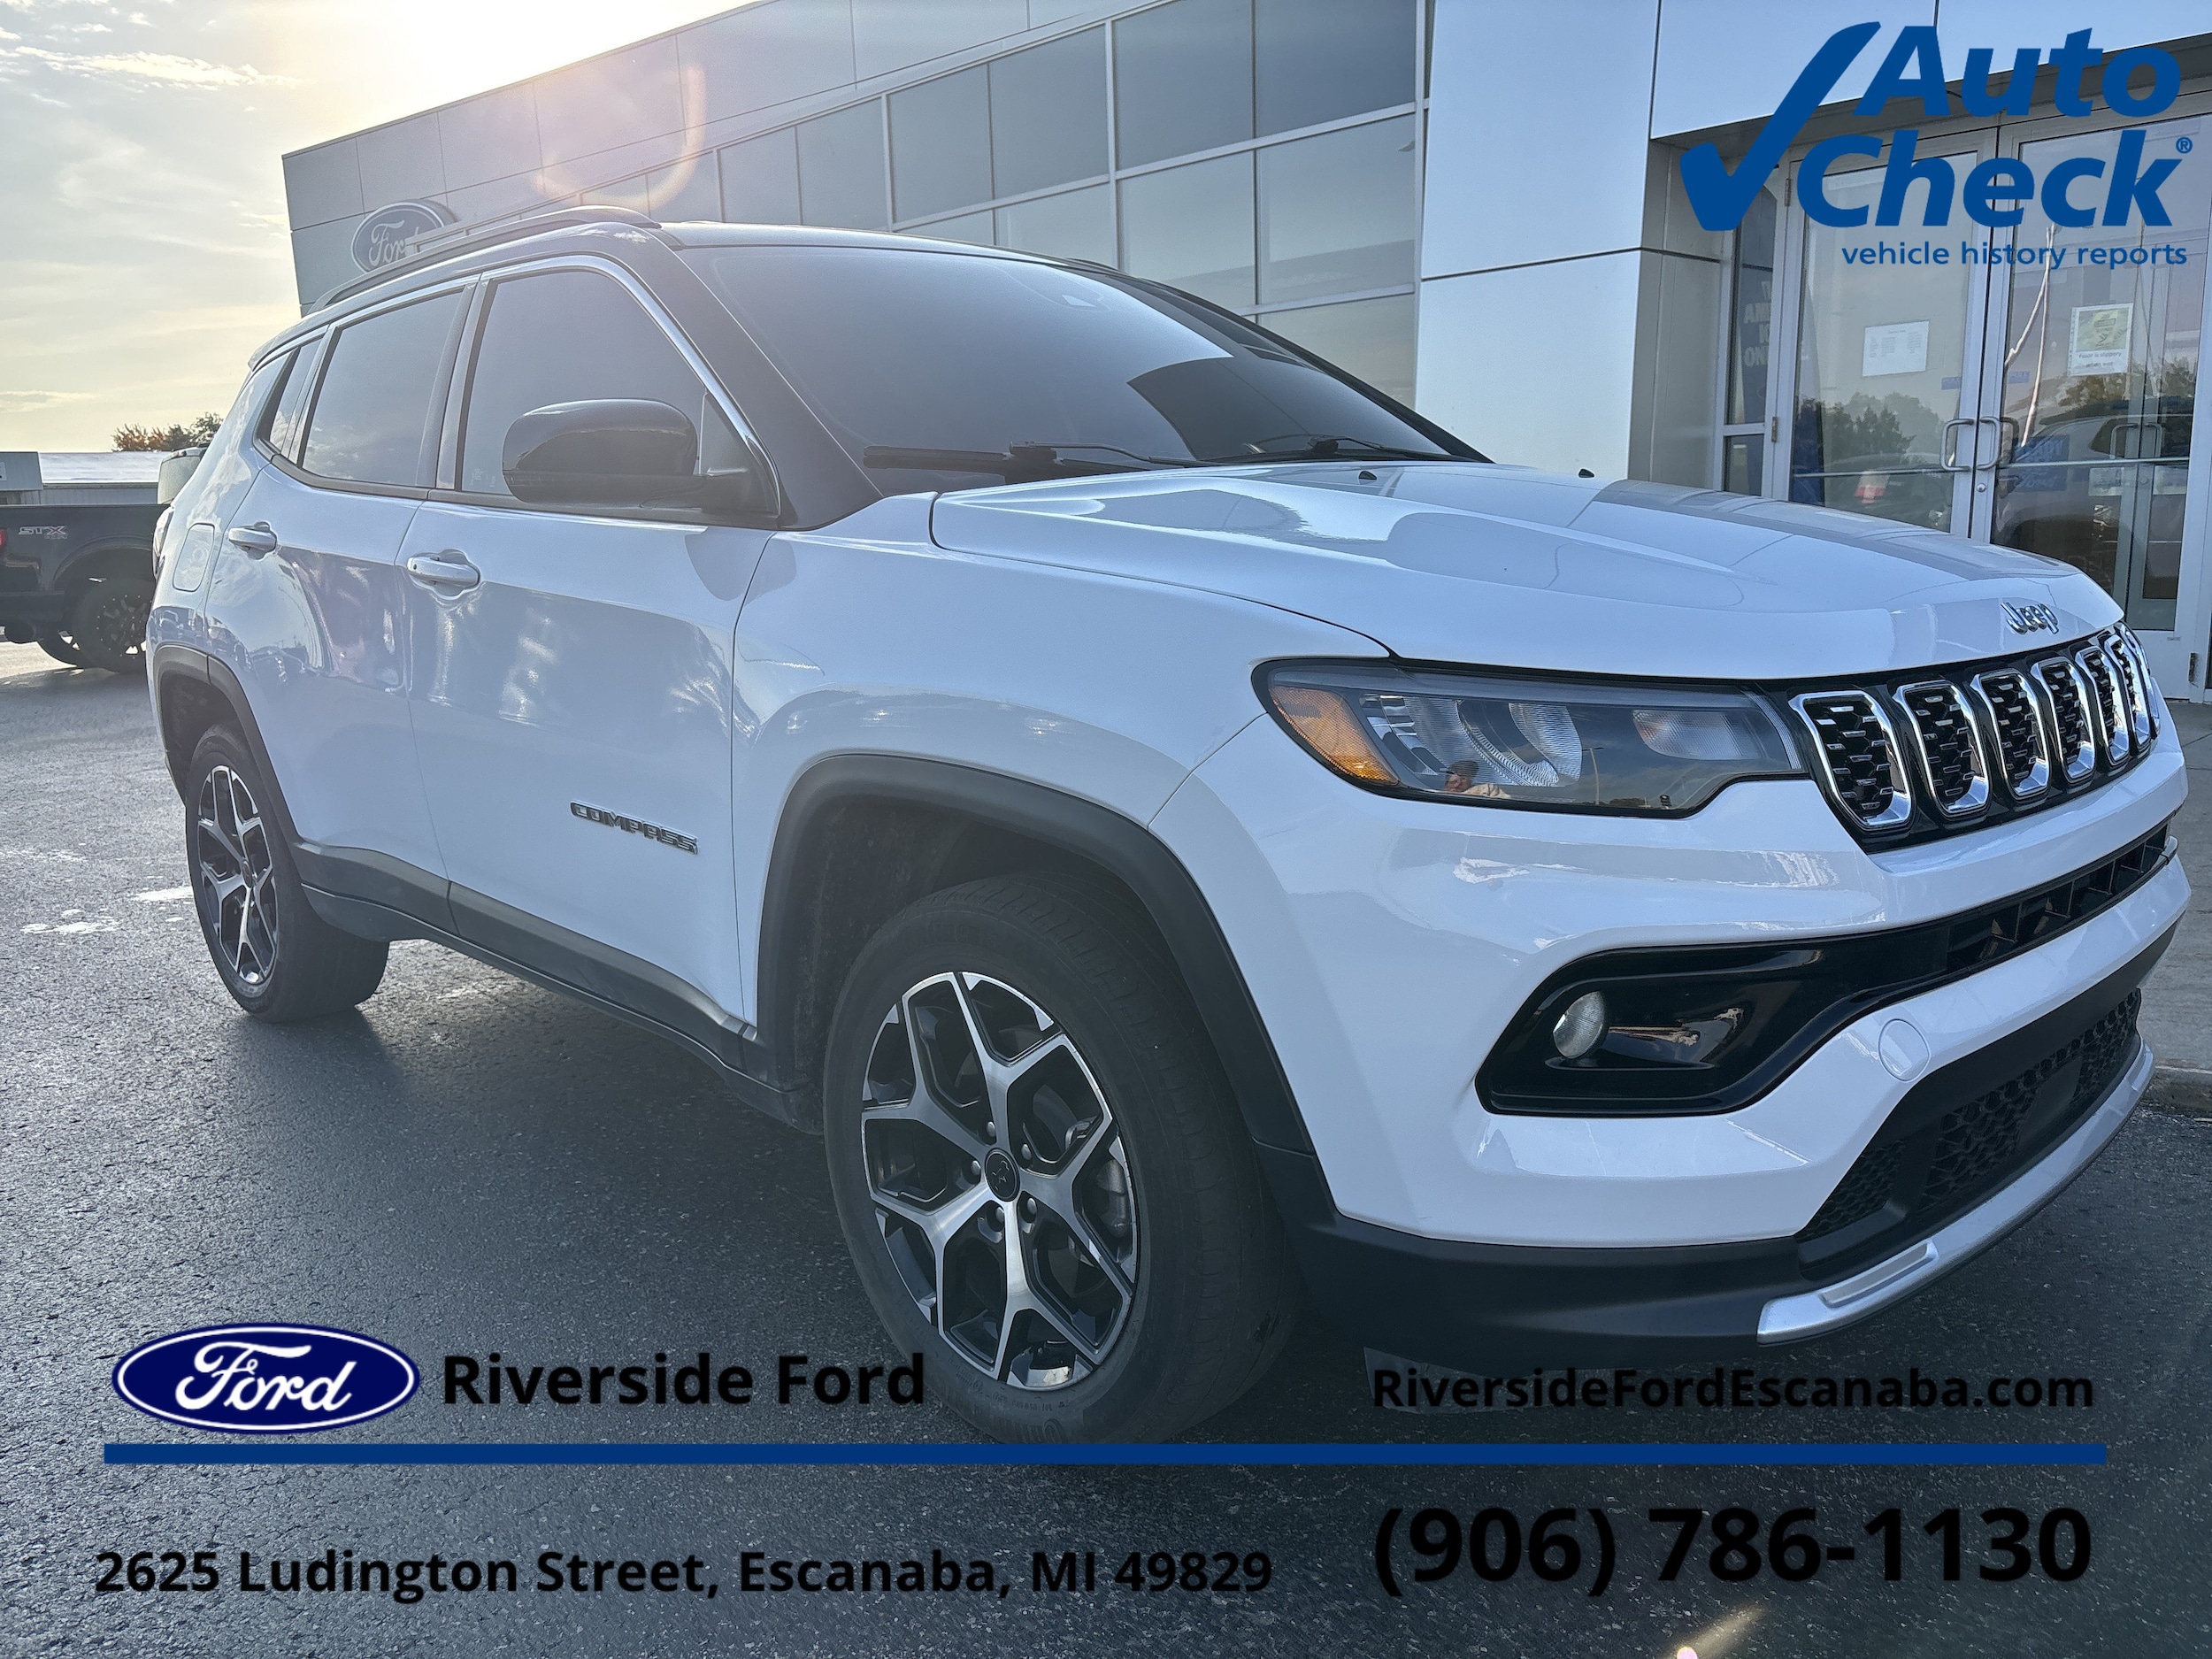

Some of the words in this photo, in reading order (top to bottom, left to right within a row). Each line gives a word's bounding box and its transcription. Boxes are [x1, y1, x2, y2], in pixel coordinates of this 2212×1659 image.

[368, 219, 419, 266] For
[2001, 602, 2059, 634] Jeep
[570, 800, 698, 856] COMPASS
